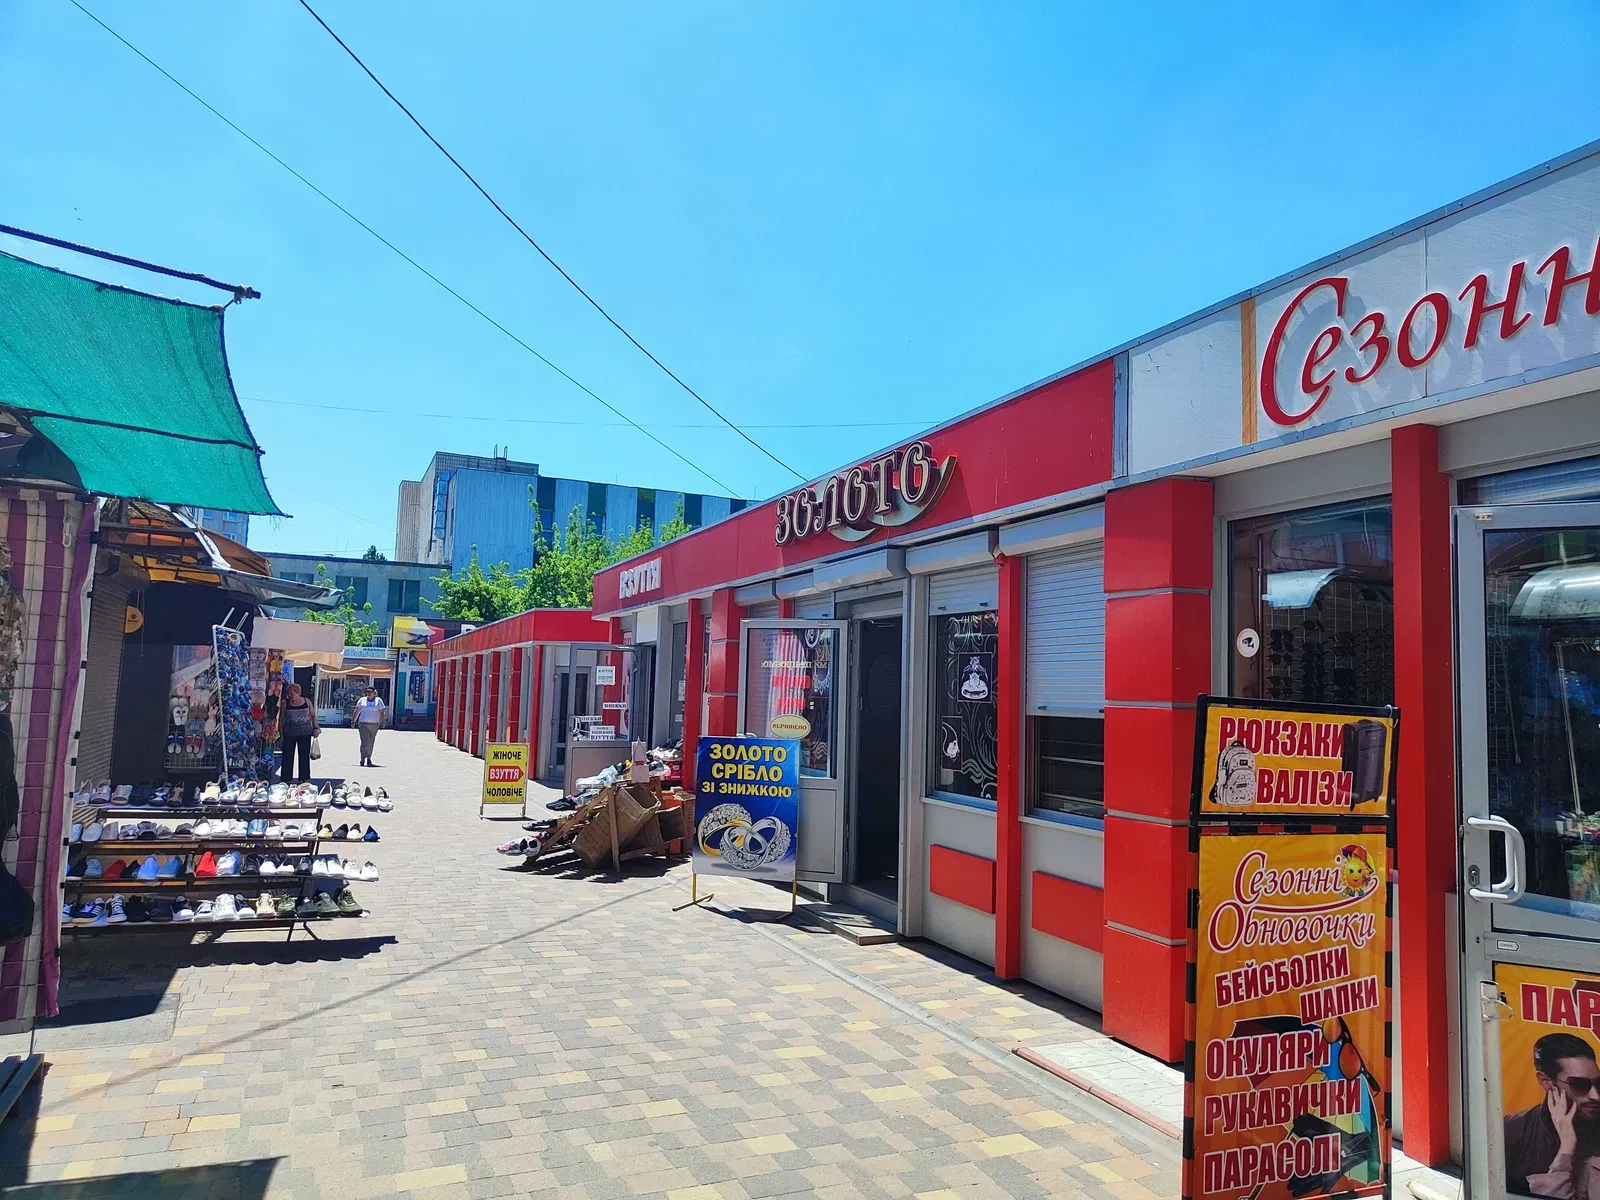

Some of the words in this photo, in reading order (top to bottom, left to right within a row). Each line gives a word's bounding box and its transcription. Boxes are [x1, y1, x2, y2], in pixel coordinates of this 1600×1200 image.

[775, 440, 937, 546] ЗОЛОТО
[619, 557, 662, 599] ВЗУТТЯ
[489, 768, 520, 779] ВЗУТТЯ
[492, 751, 522, 760] ЖІНОЧЕ
[709, 743, 787, 762] ЗОЛОТО
[711, 762, 783, 782] СРІБЛО
[486, 788, 523, 797] ЧОЛОВІЧЕ
[701, 781, 715, 793] ЗІ
[718, 782, 792, 798] ЗНИЖКОЮ
[1256, 768, 1353, 807] ВАЛІЗИ
[1234, 850, 1343, 906] Сезонні
[1208, 899, 1377, 954] Обновочки
[1215, 944, 1350, 1008] БЕЙСБОЛКИ
[1299, 975, 1380, 1026] ШАПКИ
[1519, 982, 1600, 1030] ПАР
[1206, 1028, 1332, 1082] ОКУЛЯРИ
[1204, 1076, 1362, 1137] РУКАВИЧКИ
[1203, 1132, 1341, 1194] ПАРАСОЛІ
